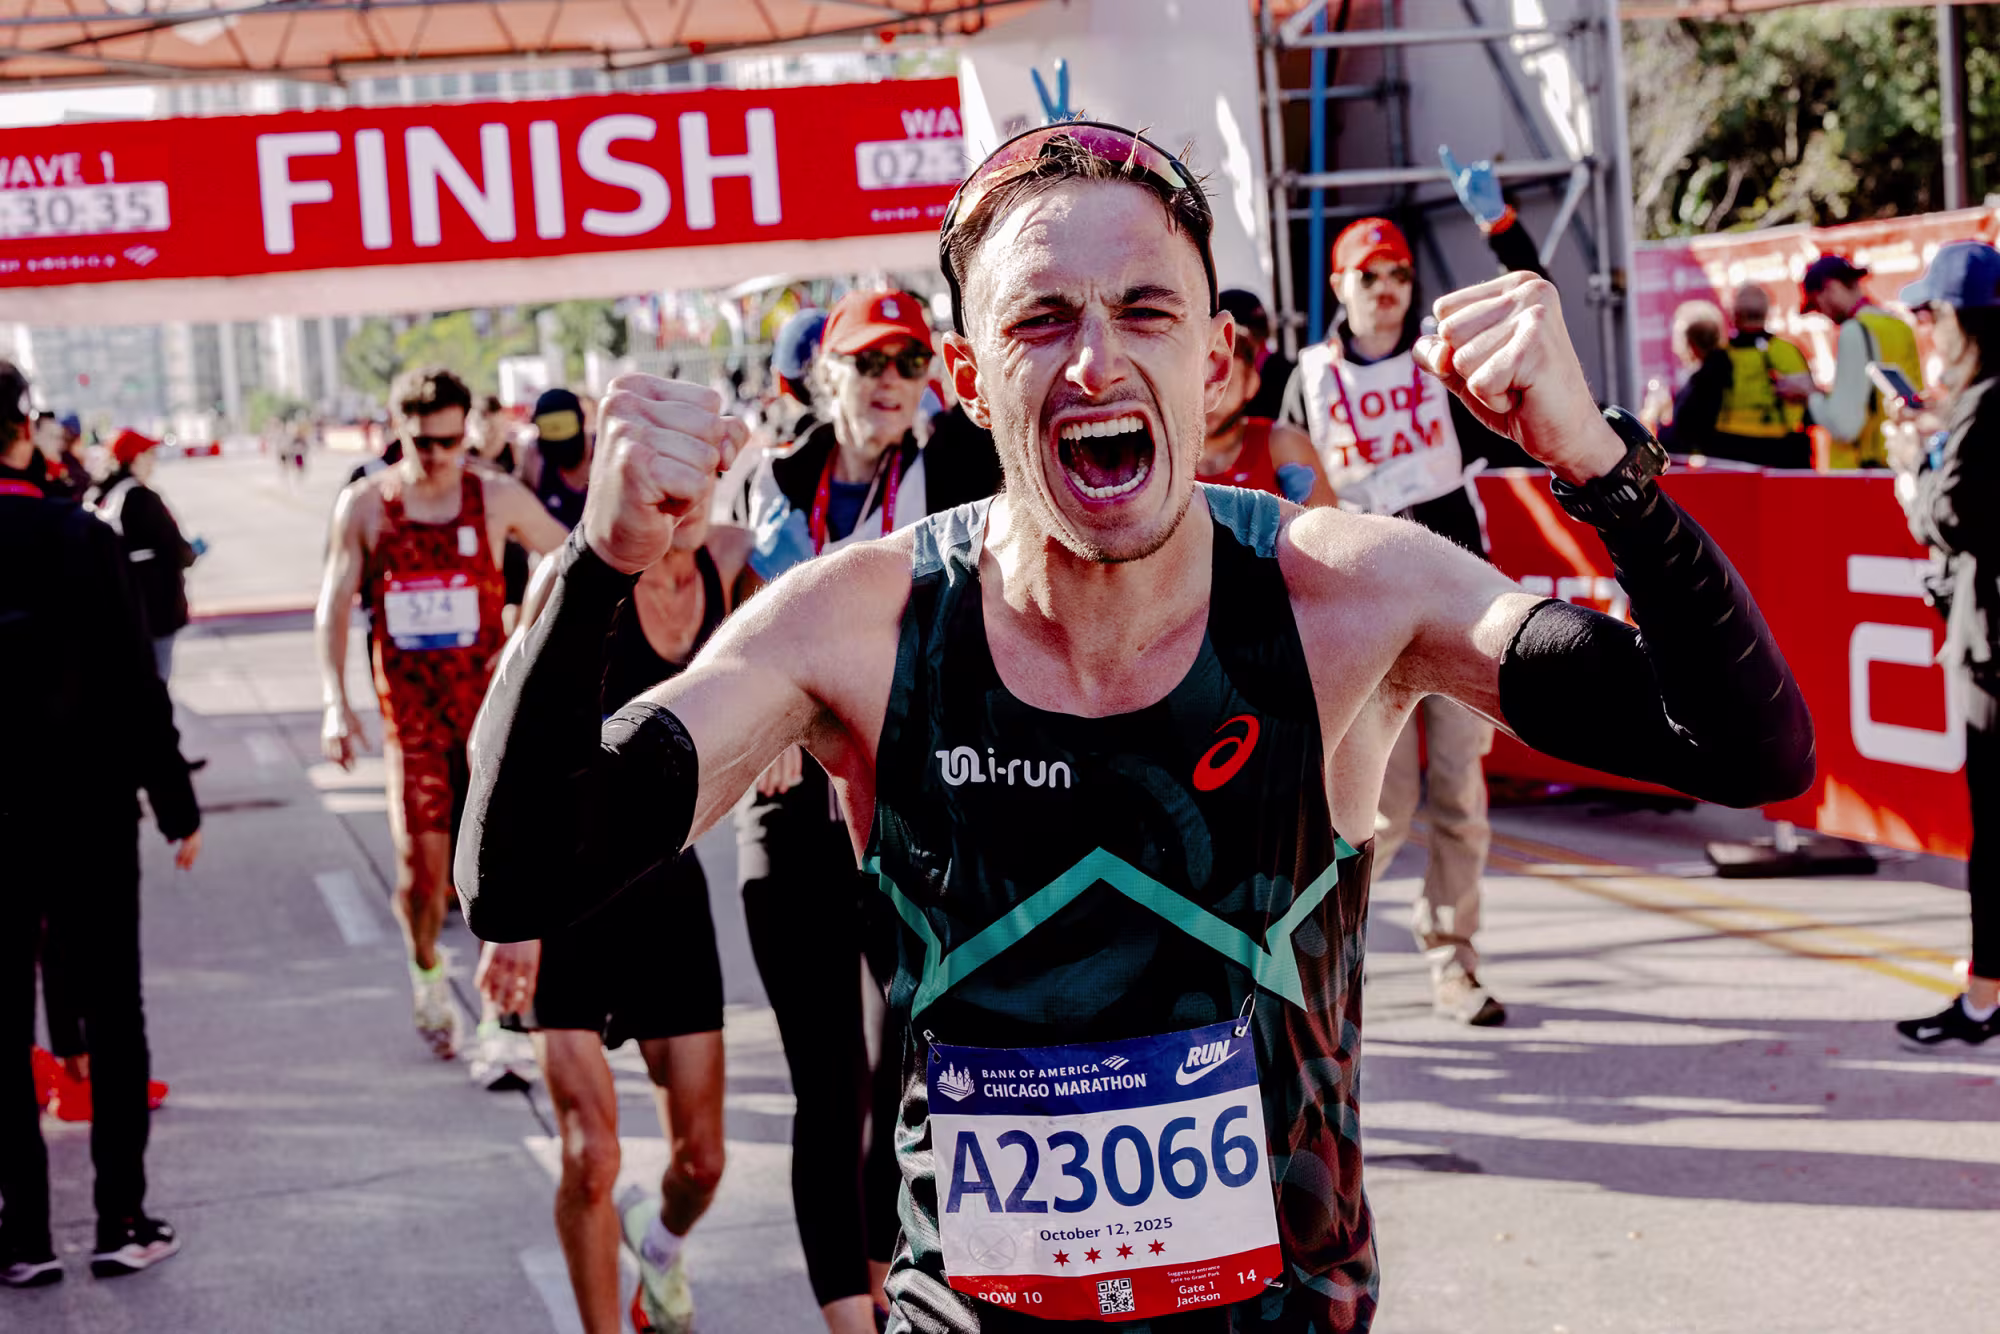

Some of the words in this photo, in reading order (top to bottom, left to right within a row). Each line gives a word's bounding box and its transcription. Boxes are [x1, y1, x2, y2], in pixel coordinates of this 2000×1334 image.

[901, 107, 962, 137] WA
[0, 153, 84, 186] AVE
[256, 107, 782, 255] FINISH
[987, 747, 1071, 789] i-run
[1185, 1039, 1230, 1067] RUN
[981, 1069, 1016, 1079] BANK
[1019, 1069, 1035, 1078] OF
[1038, 1063, 1100, 1078] AMERICA
[983, 1083, 1050, 1098] CHICAGO
[1053, 1073, 1147, 1097] MARATHON
[945, 1105, 1259, 1214] A23066
[1040, 1227, 1100, 1241] October
[1106, 1223, 1130, 1236] 12,
[1133, 1216, 1173, 1233] 2025
[1167, 1268, 1196, 1277] Suggested
[1196, 1265, 1220, 1273] entrance
[1237, 1269, 1257, 1284] 14
[978, 1292, 1017, 1305] ROW
[1023, 1291, 1043, 1304] 10
[1176, 1292, 1221, 1308] Jackson
[1179, 1284, 1205, 1295] Gate
[1209, 1281, 1215, 1290] 1
